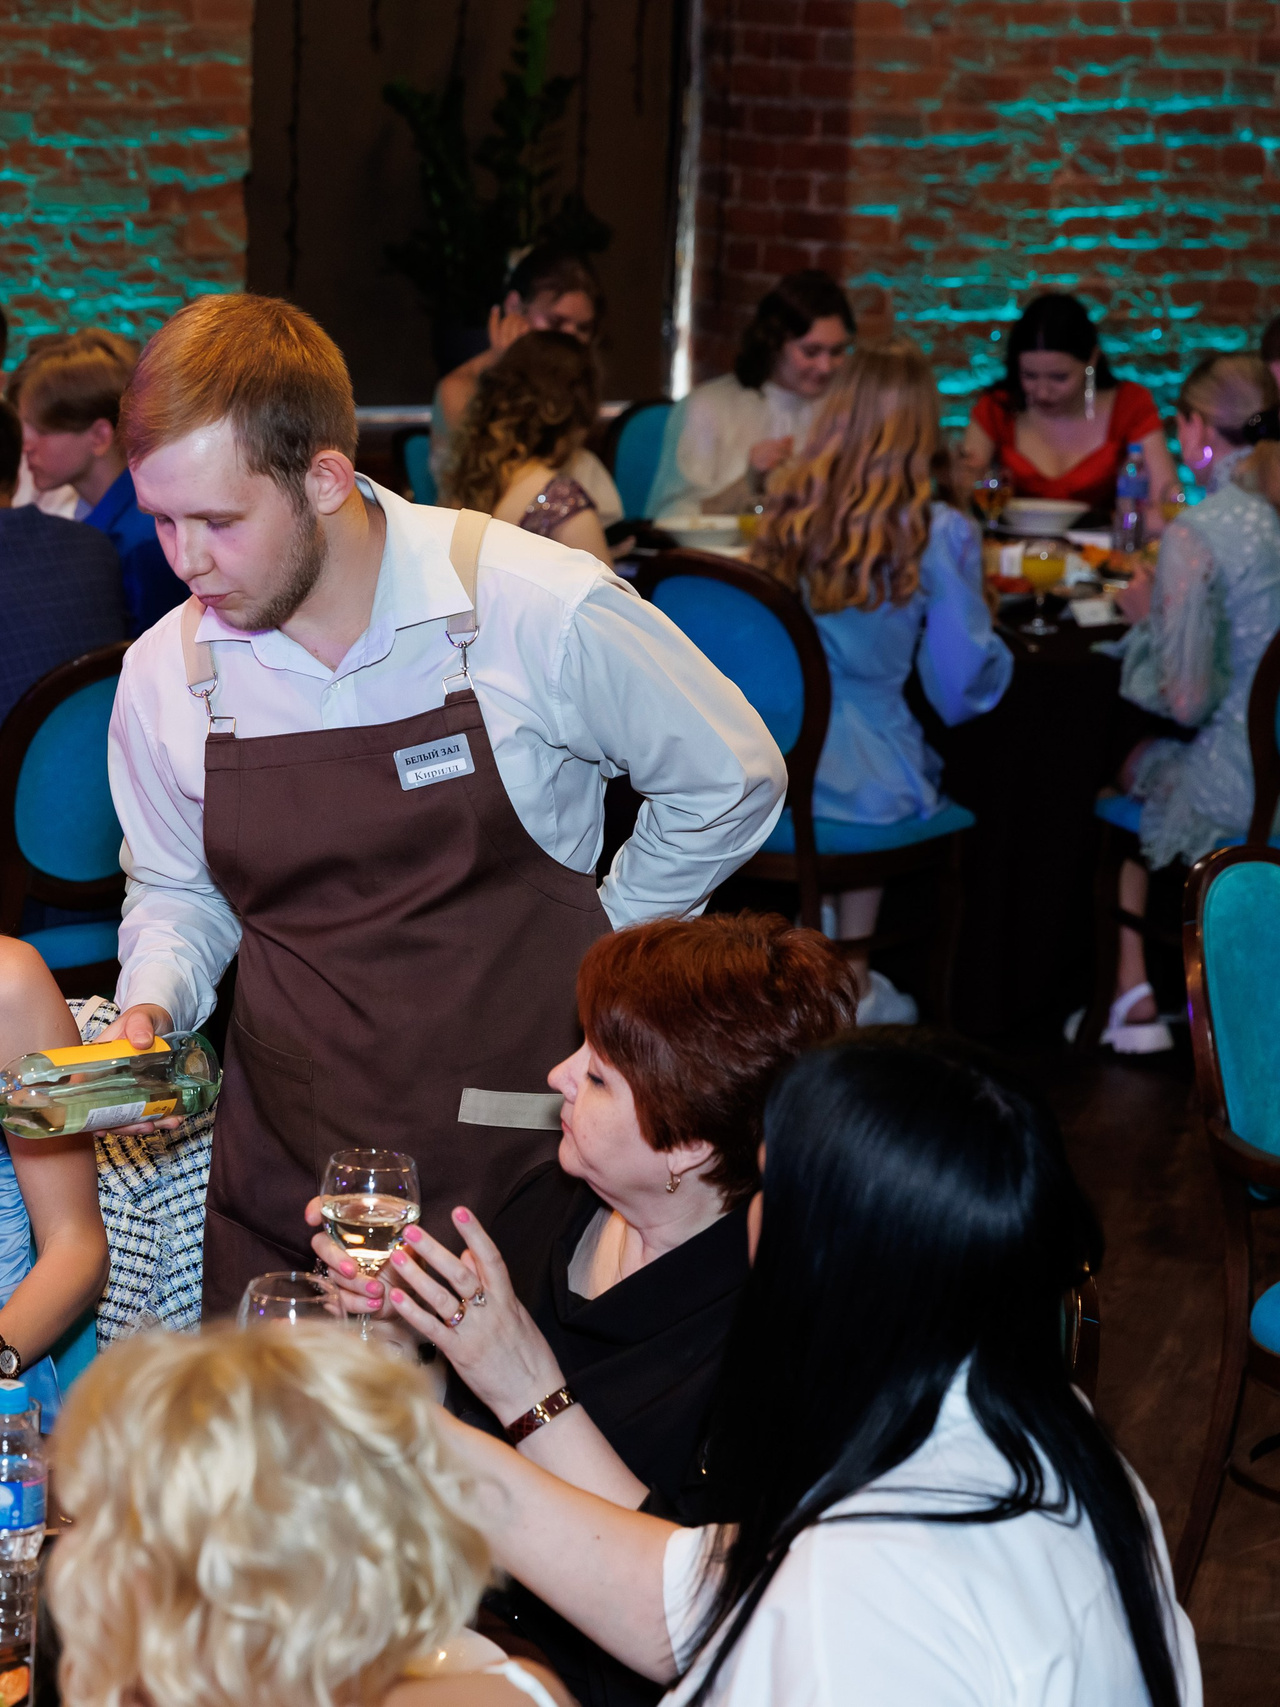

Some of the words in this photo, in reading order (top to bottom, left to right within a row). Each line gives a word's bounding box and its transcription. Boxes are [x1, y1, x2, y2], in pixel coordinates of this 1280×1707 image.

[405, 749, 439, 766] БЕЛЫЙ
[440, 744, 461, 757] ЗАЛ
[414, 765, 459, 781] Кирилл
